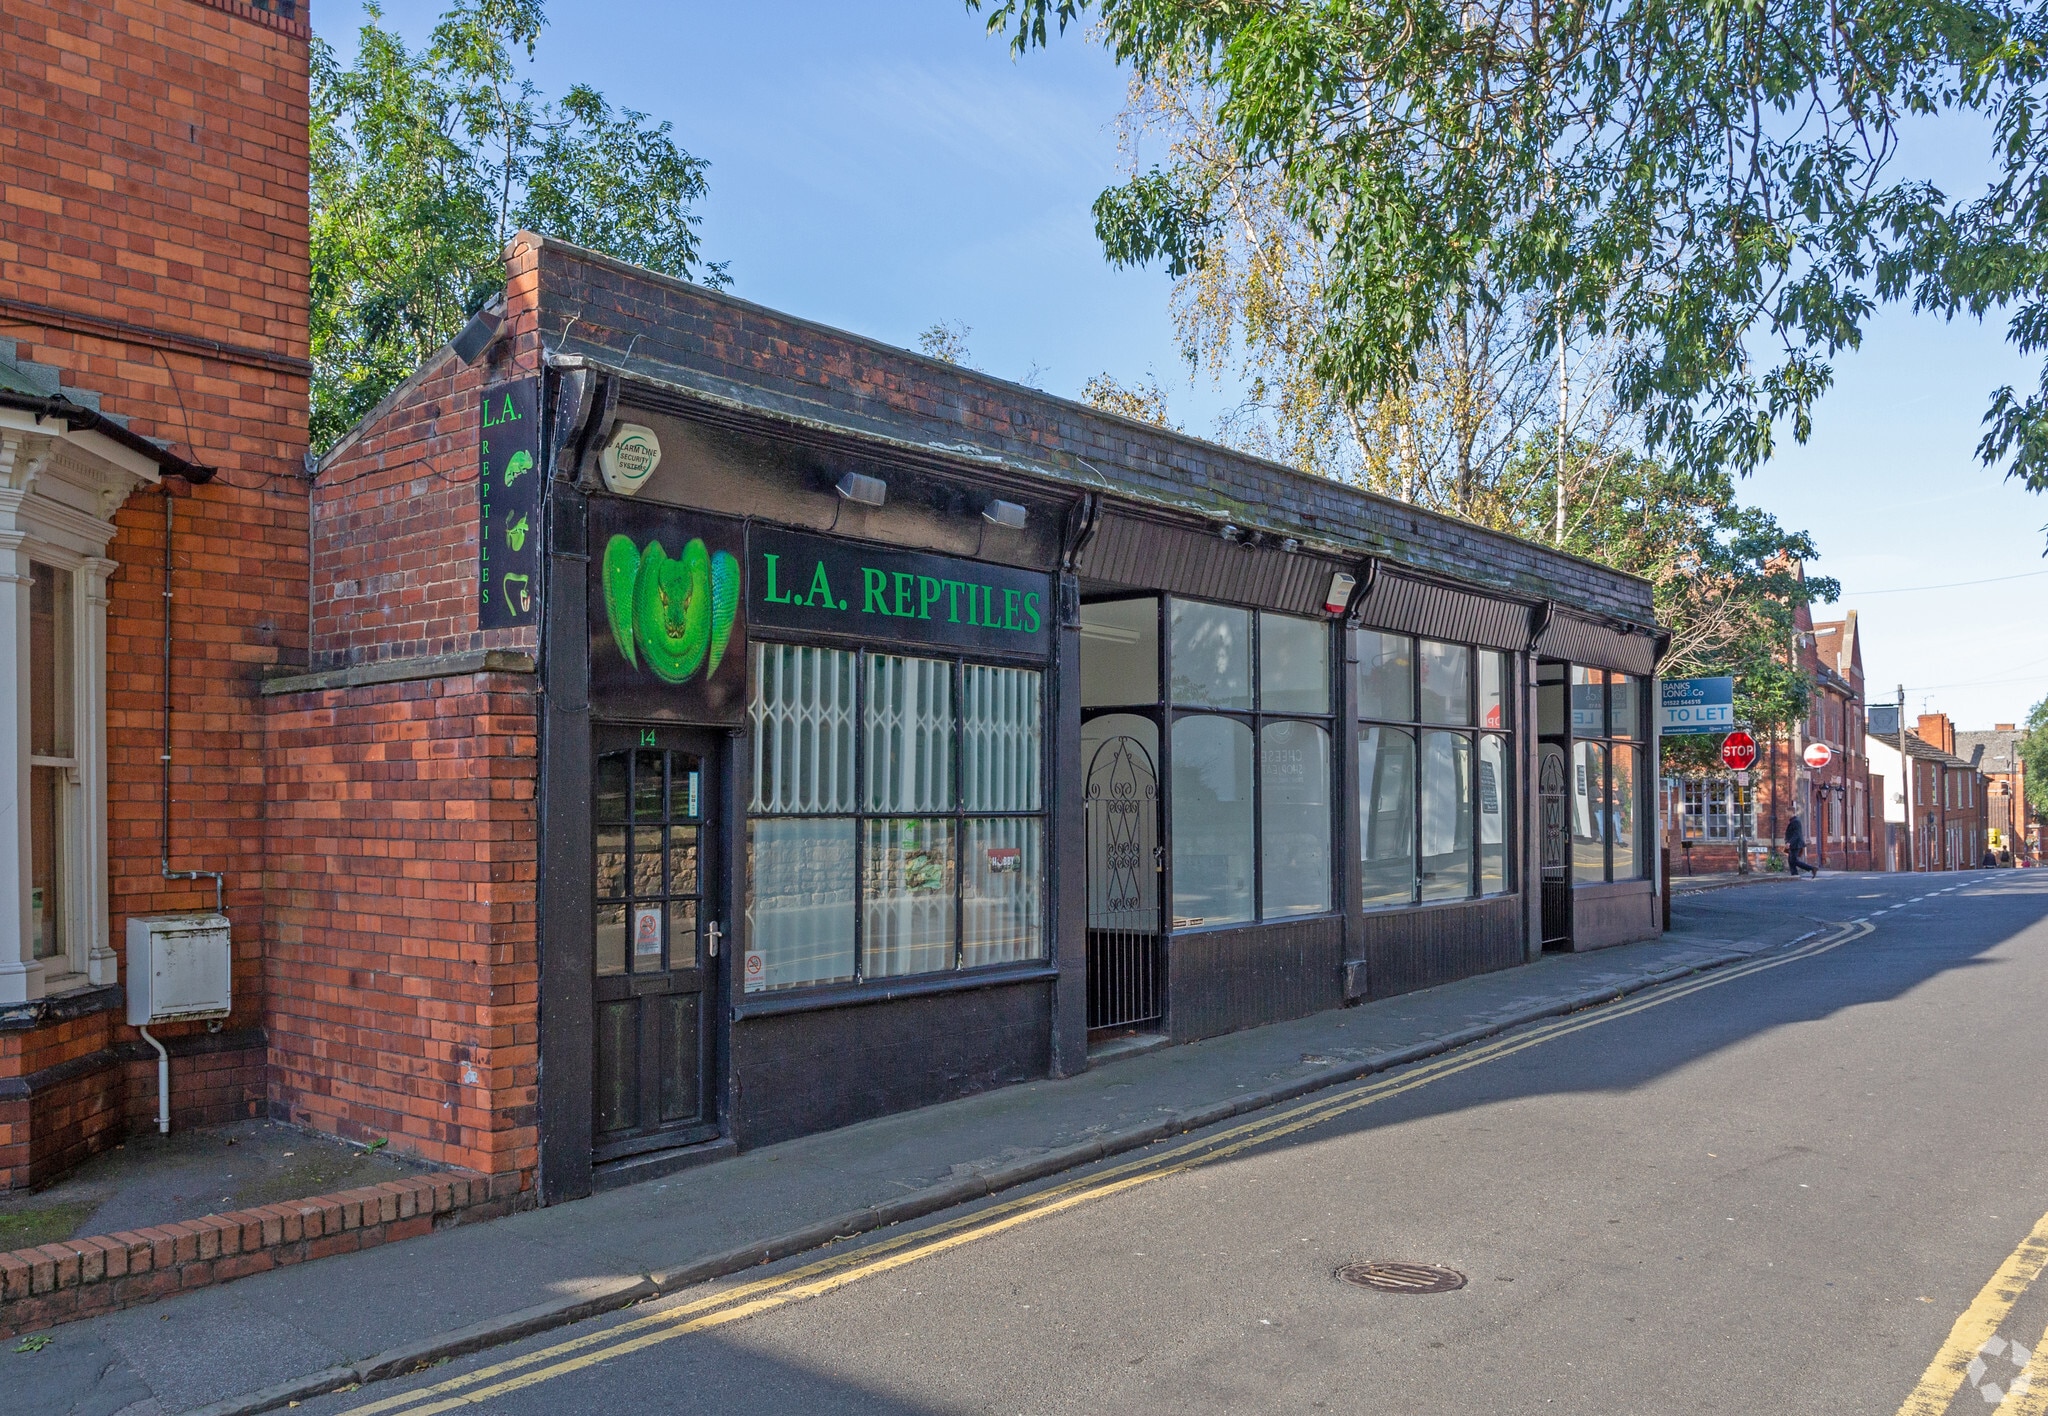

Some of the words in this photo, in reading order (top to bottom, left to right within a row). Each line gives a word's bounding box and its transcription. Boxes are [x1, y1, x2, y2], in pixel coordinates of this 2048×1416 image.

[483, 393, 522, 428] L.A.
[615, 442, 640, 453] ALARM
[641, 448, 657, 457] LINE
[620, 453, 648, 463] SECURITY
[619, 462, 647, 471] SYSTEMS
[482, 440, 490, 604] REPTILES
[764, 553, 847, 611] L.A.
[861, 567, 1041, 633] REPTILES
[1662, 682, 1690, 690] BANKS
[1667, 708, 1690, 722] TO
[1696, 707, 1728, 720] LET
[640, 728, 656, 746] 14
[1723, 745, 1754, 757] STOP
